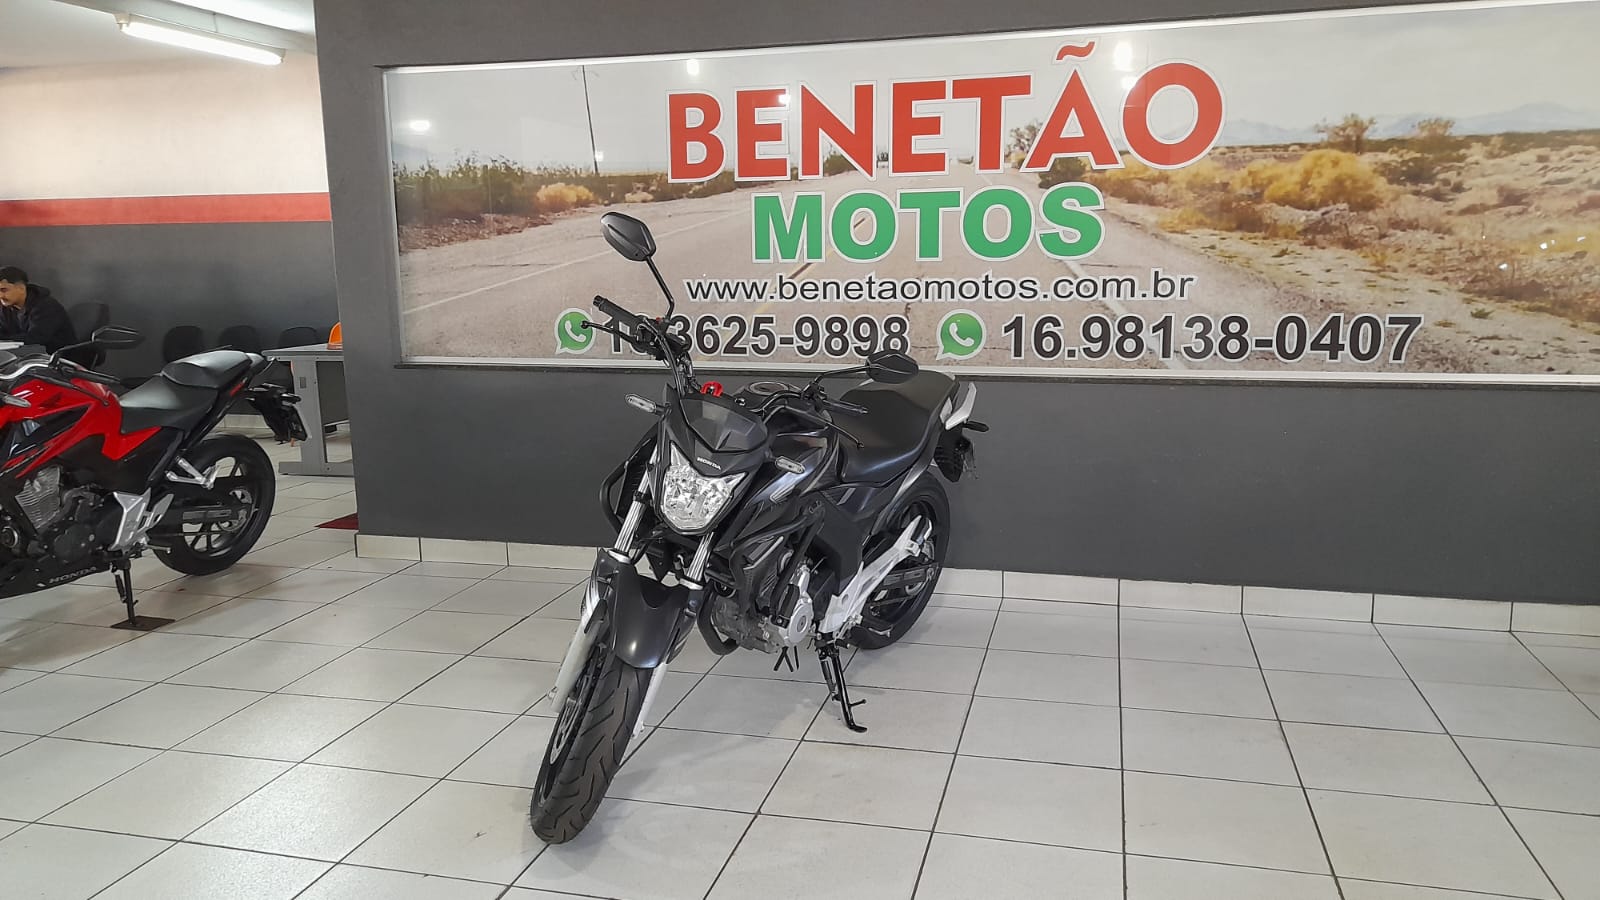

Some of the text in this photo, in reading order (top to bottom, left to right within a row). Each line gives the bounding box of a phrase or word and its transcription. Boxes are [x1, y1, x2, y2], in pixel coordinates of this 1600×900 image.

[668, 41, 1223, 182] BENETÃO
[754, 184, 1104, 261] MOTOS
[686, 271, 1194, 301] www.benetaomotos.com.br
[1003, 315, 1422, 361] 16.98138-0407
[697, 456, 721, 470] HONDA
